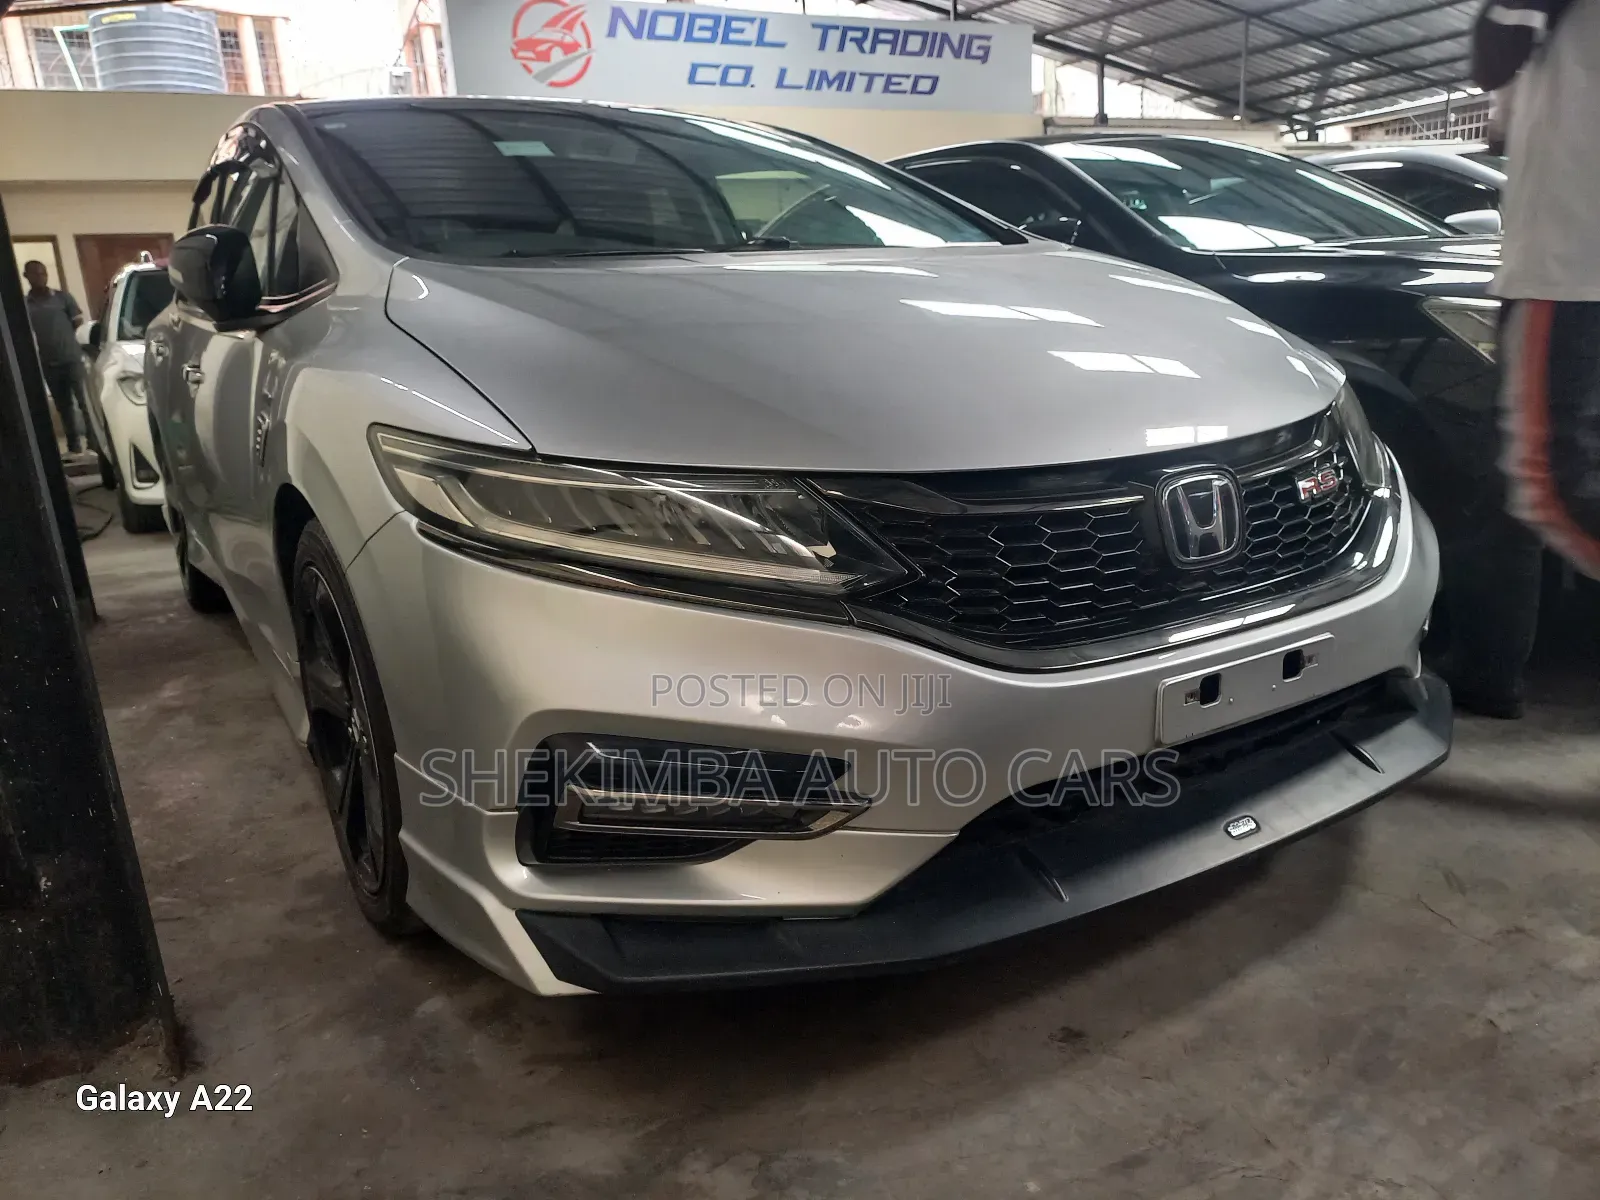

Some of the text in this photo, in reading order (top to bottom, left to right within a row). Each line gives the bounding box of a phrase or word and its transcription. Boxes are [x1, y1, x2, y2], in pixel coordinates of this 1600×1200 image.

[606, 6, 992, 64] NOBEL TRADING
[688, 62, 940, 95] CO. LIMITED
[1297, 469, 1338, 500] RS
